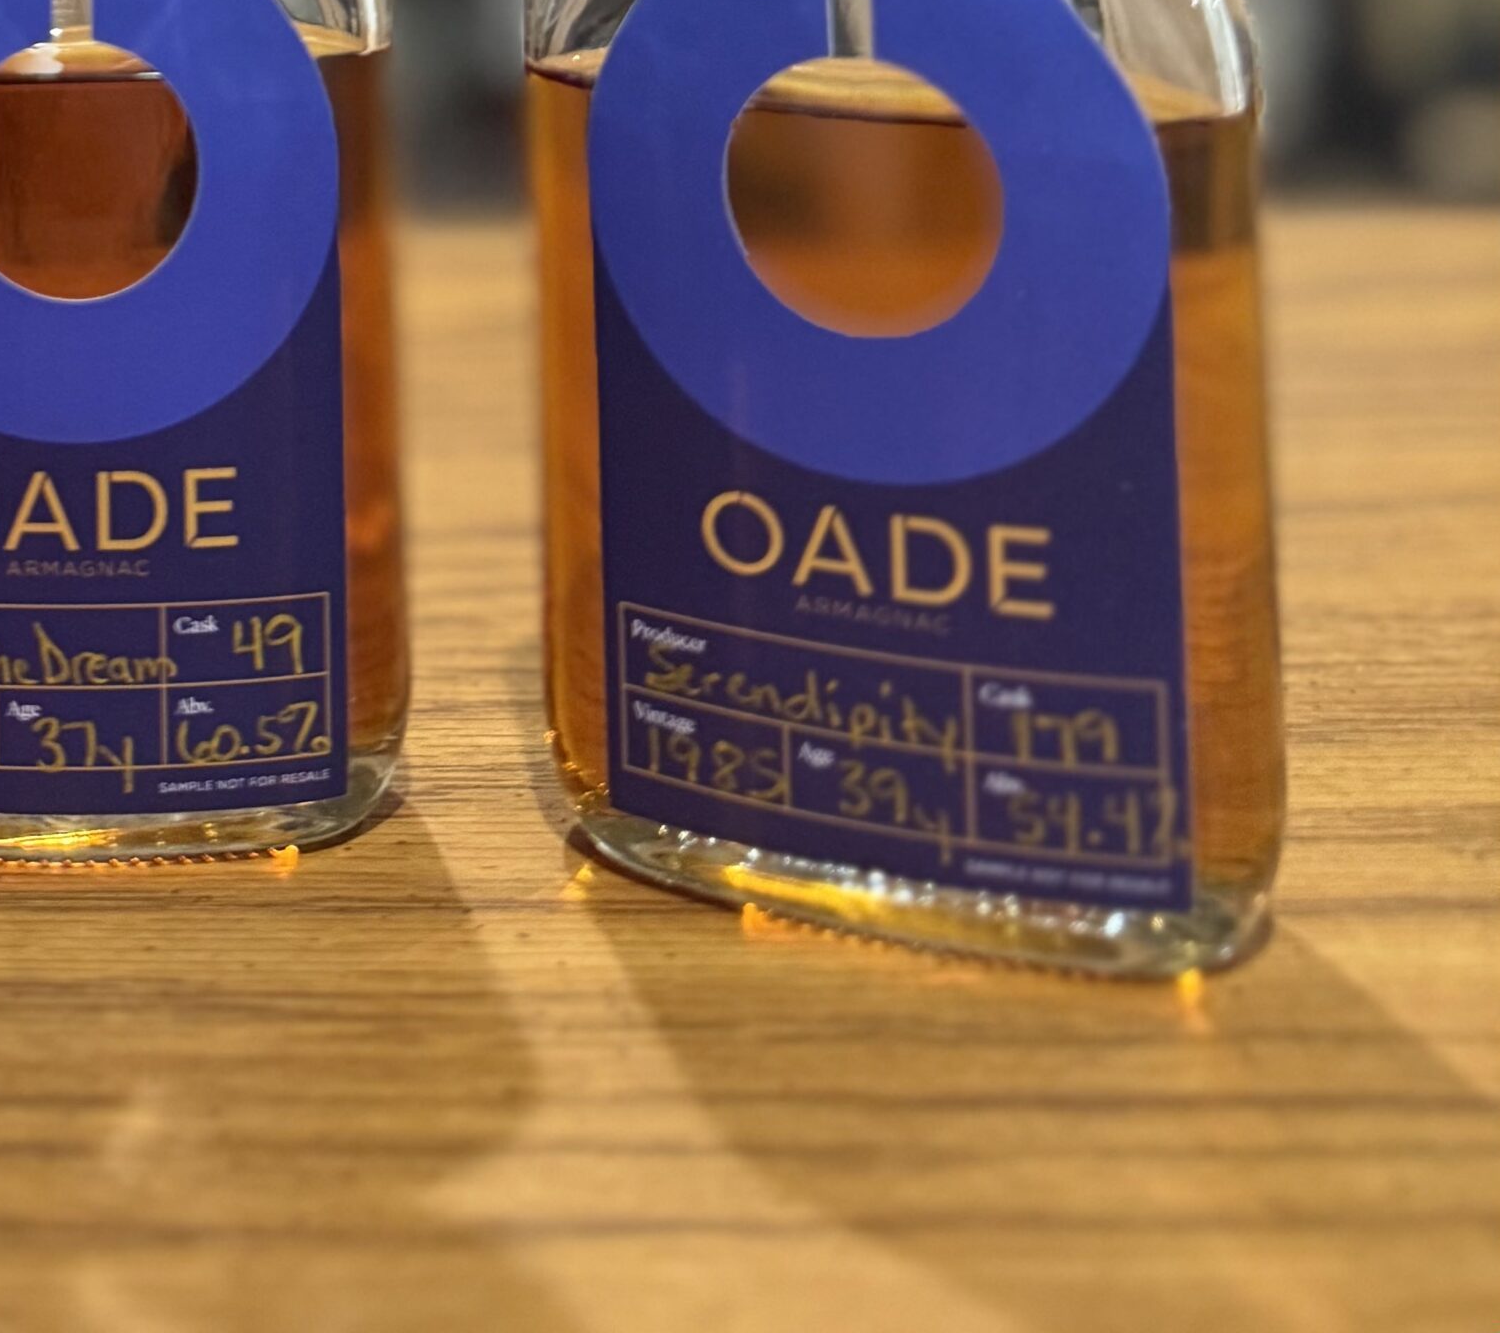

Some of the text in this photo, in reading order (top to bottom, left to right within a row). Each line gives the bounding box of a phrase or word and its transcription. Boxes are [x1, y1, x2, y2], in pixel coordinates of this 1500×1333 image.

[702, 490, 1054, 619] OADE
[6, 558, 152, 578] ARMAGNAC
[173, 615, 219, 635] Cask
[794, 593, 952, 634] ARMAGNAC
[231, 613, 303, 674] 49
[6, 699, 40, 721] Age
[158, 768, 331, 794] SAMPLE NOT FOR RESALE
